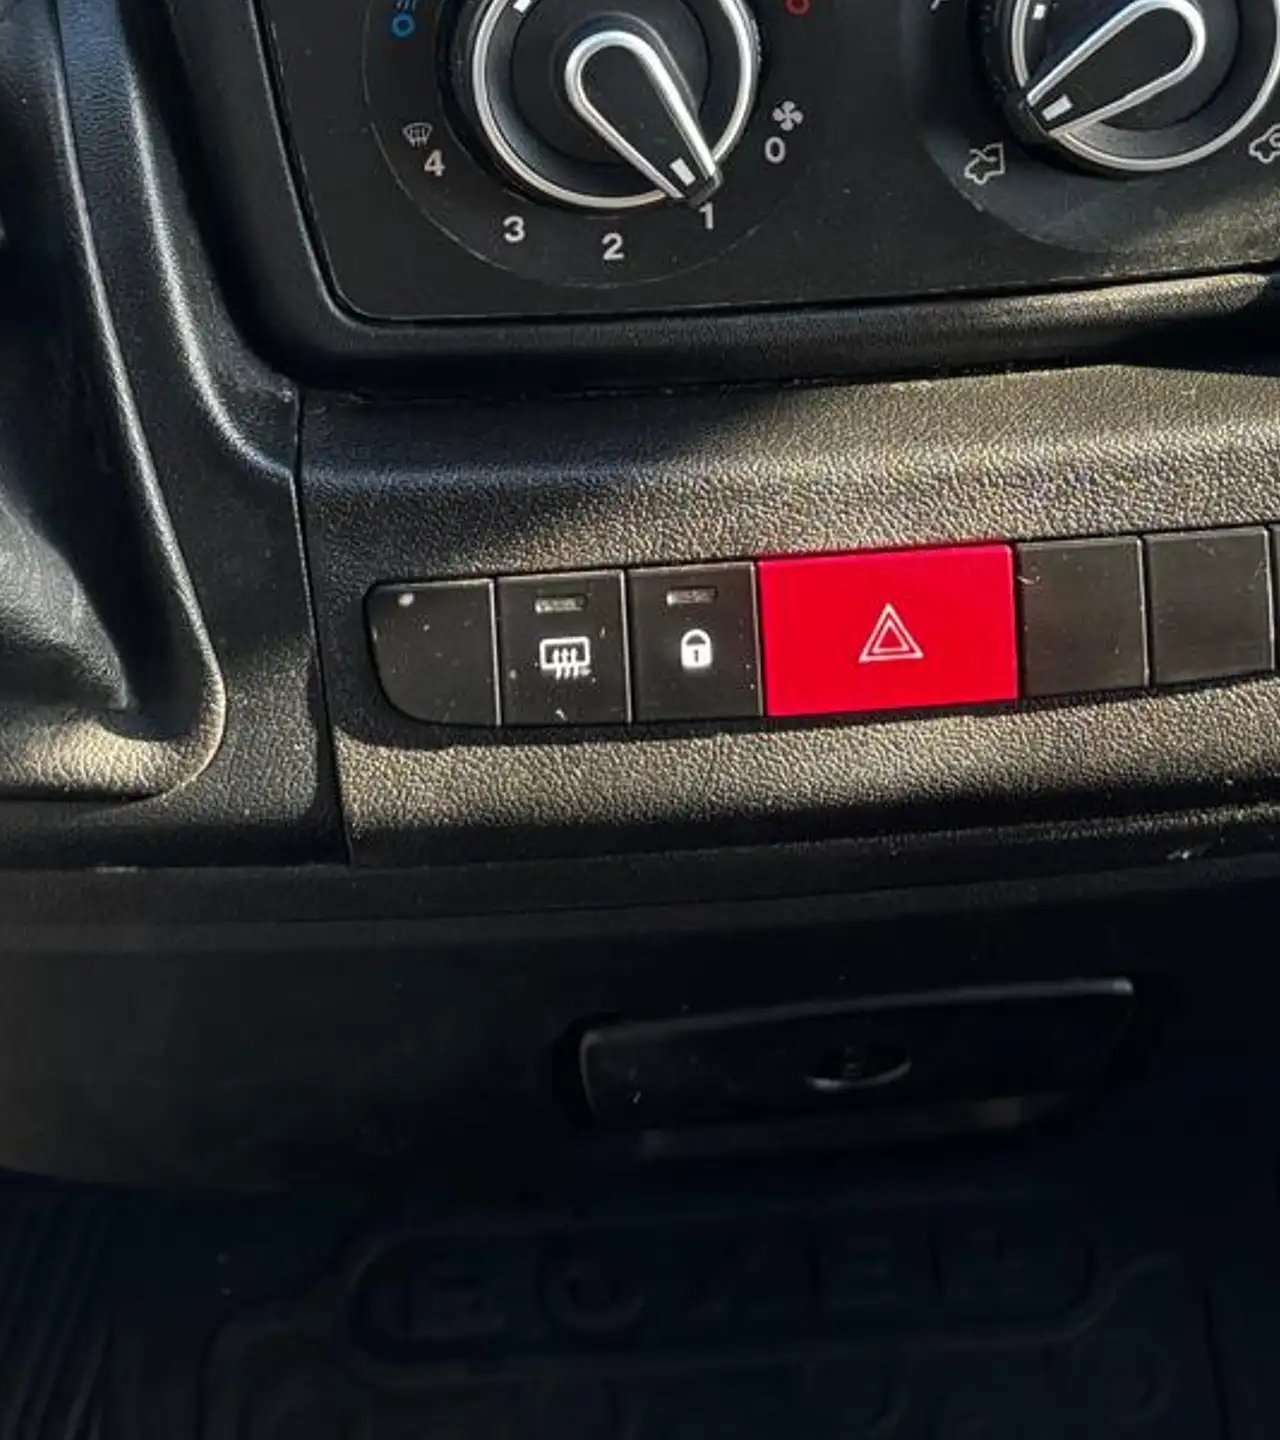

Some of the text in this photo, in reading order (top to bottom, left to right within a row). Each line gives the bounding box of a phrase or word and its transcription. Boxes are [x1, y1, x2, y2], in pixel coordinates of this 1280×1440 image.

[422, 148, 446, 178] 4
[764, 135, 787, 164] 0
[502, 215, 526, 244] 3
[698, 203, 715, 231] 1
[600, 232, 625, 262] 2
